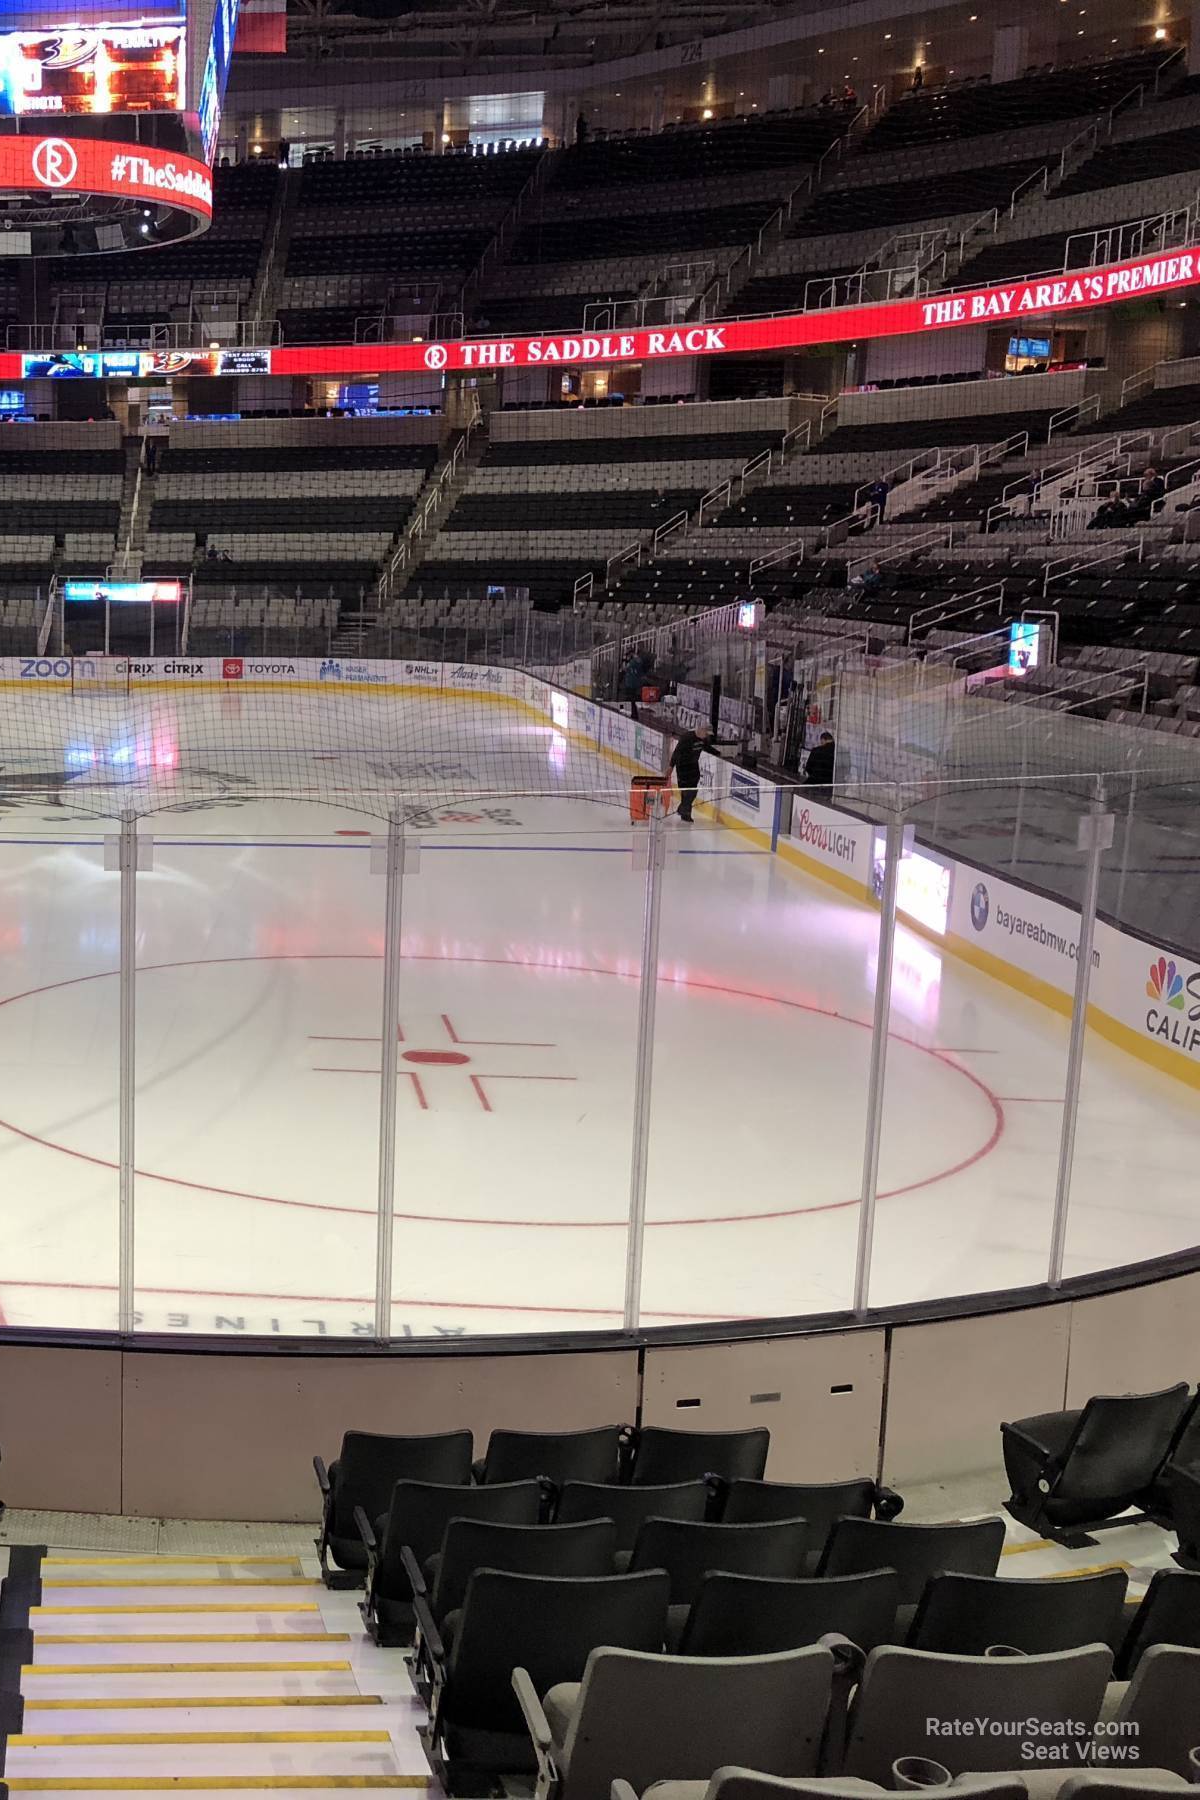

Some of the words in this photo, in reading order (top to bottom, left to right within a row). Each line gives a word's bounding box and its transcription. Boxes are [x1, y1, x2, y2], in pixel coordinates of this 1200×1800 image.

[922, 298, 967, 326] THE
[970, 288, 1018, 318] BAY
[1018, 275, 1104, 312] AREA'S
[1106, 255, 1194, 297] PREMIER
[460, 344, 515, 365] THE
[527, 335, 636, 362] SADDLE
[647, 327, 727, 354] RACK
[247, 664, 295, 674] TOYOTA
[799, 809, 828, 851] Coors
[827, 830, 857, 863] LIGHT
[116, 1311, 467, 1338] AIRLINES
